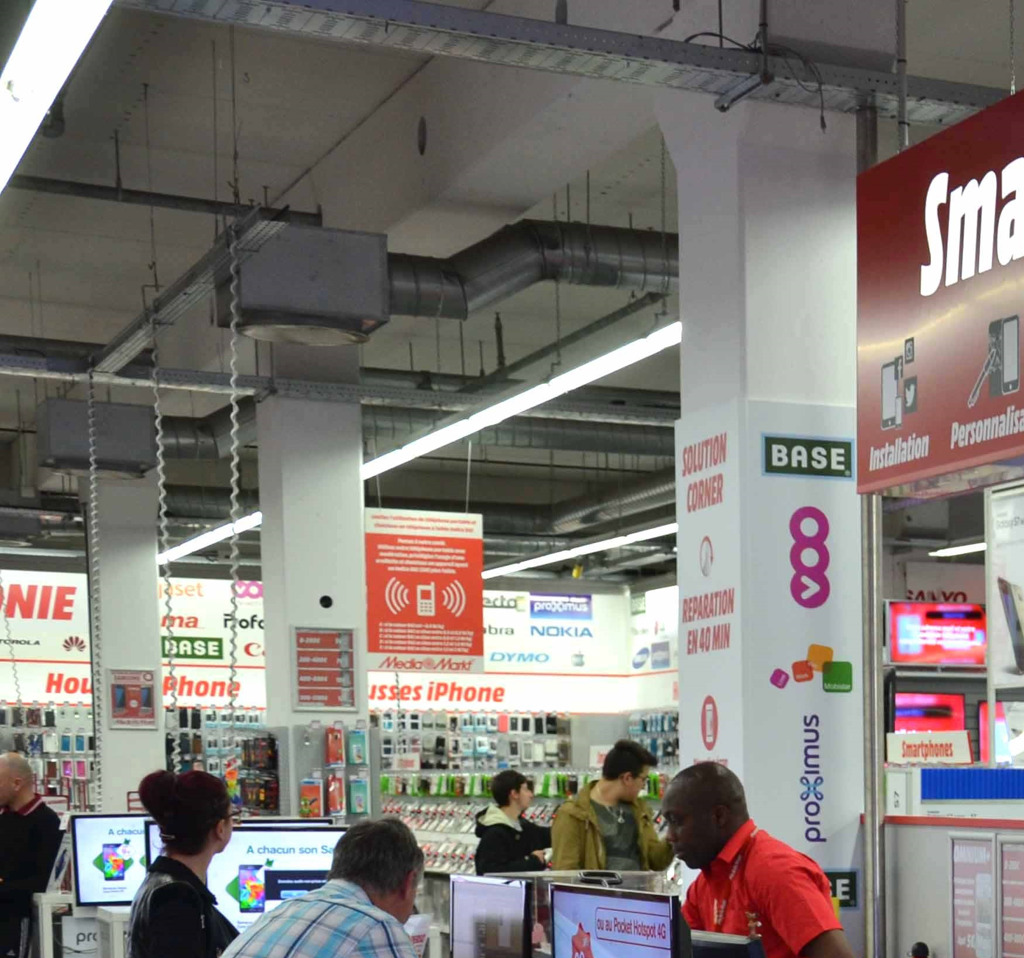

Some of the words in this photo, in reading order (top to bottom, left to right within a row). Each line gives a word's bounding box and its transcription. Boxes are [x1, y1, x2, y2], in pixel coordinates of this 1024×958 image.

[682, 432, 727, 477] SOLUTION
[772, 444, 845, 470] BASE
[869, 433, 929, 472] Installation
[687, 473, 723, 513] CORNER
[0, 584, 77, 620] NIE
[682, 588, 734, 623] REPARATION
[531, 626, 593, 638] NOKIA
[687, 629, 698, 655] EN
[700, 626, 711, 652] 40
[712, 623, 730, 650] MIN
[164, 639, 220, 656] BASE
[490, 652, 549, 663] DYMO
[427, 682, 505, 702] iPhone
[901, 741, 953, 759] Smartphones
[800, 714, 827, 842] proximus
[246, 846, 255, 855] A
[257, 846, 295, 855] chacun
[297, 847, 318, 855] son
[597, 919, 604, 931] ou
[605, 921, 612, 932] au
[614, 917, 632, 935] Pocket
[633, 920, 656, 939] Hotspot
[657, 923, 666, 939] 4G
